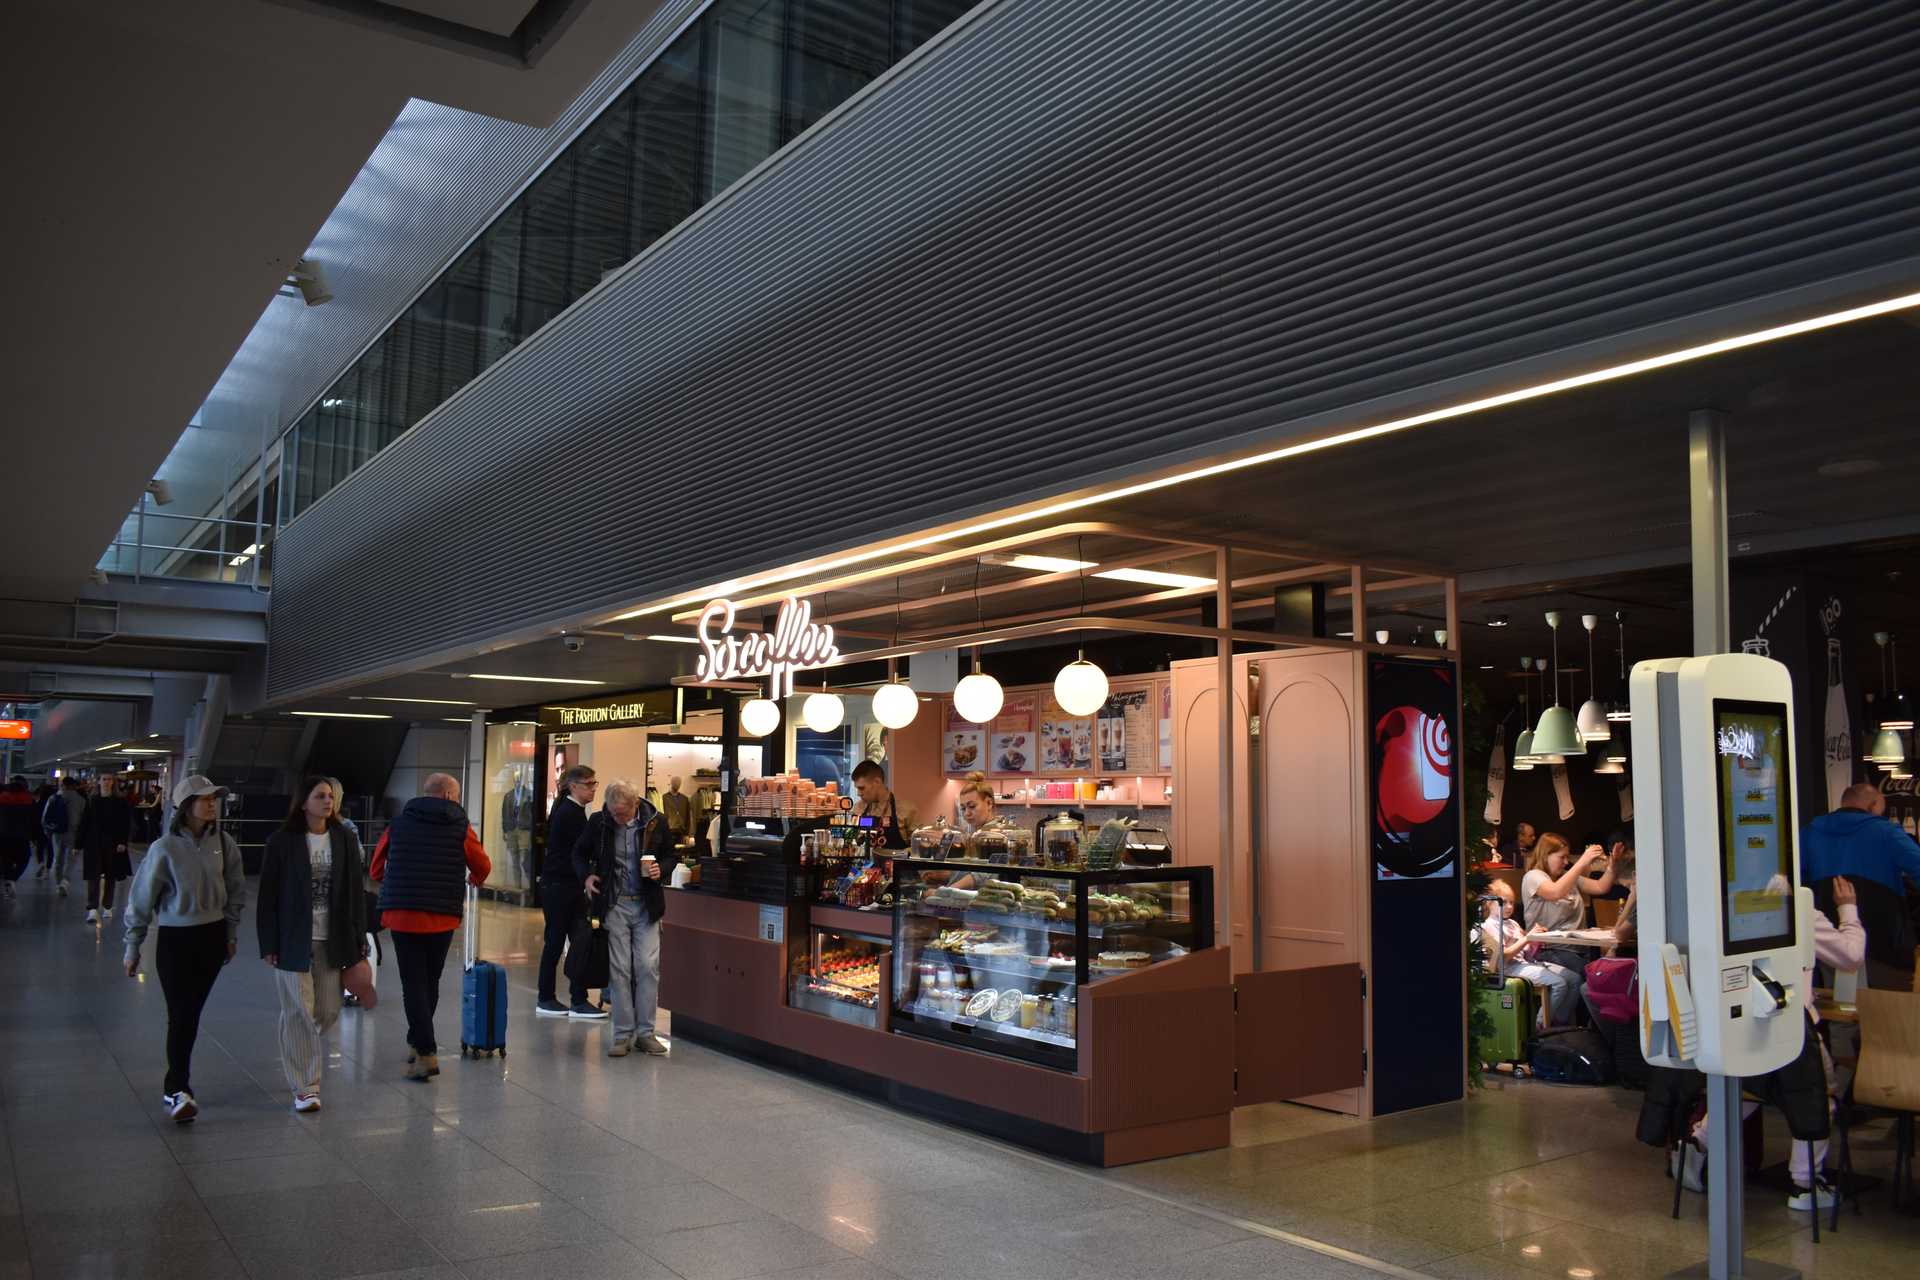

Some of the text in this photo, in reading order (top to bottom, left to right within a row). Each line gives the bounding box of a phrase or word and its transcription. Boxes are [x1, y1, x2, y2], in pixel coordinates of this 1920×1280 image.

[560, 703, 645, 725] THE FASHION GALLERY
